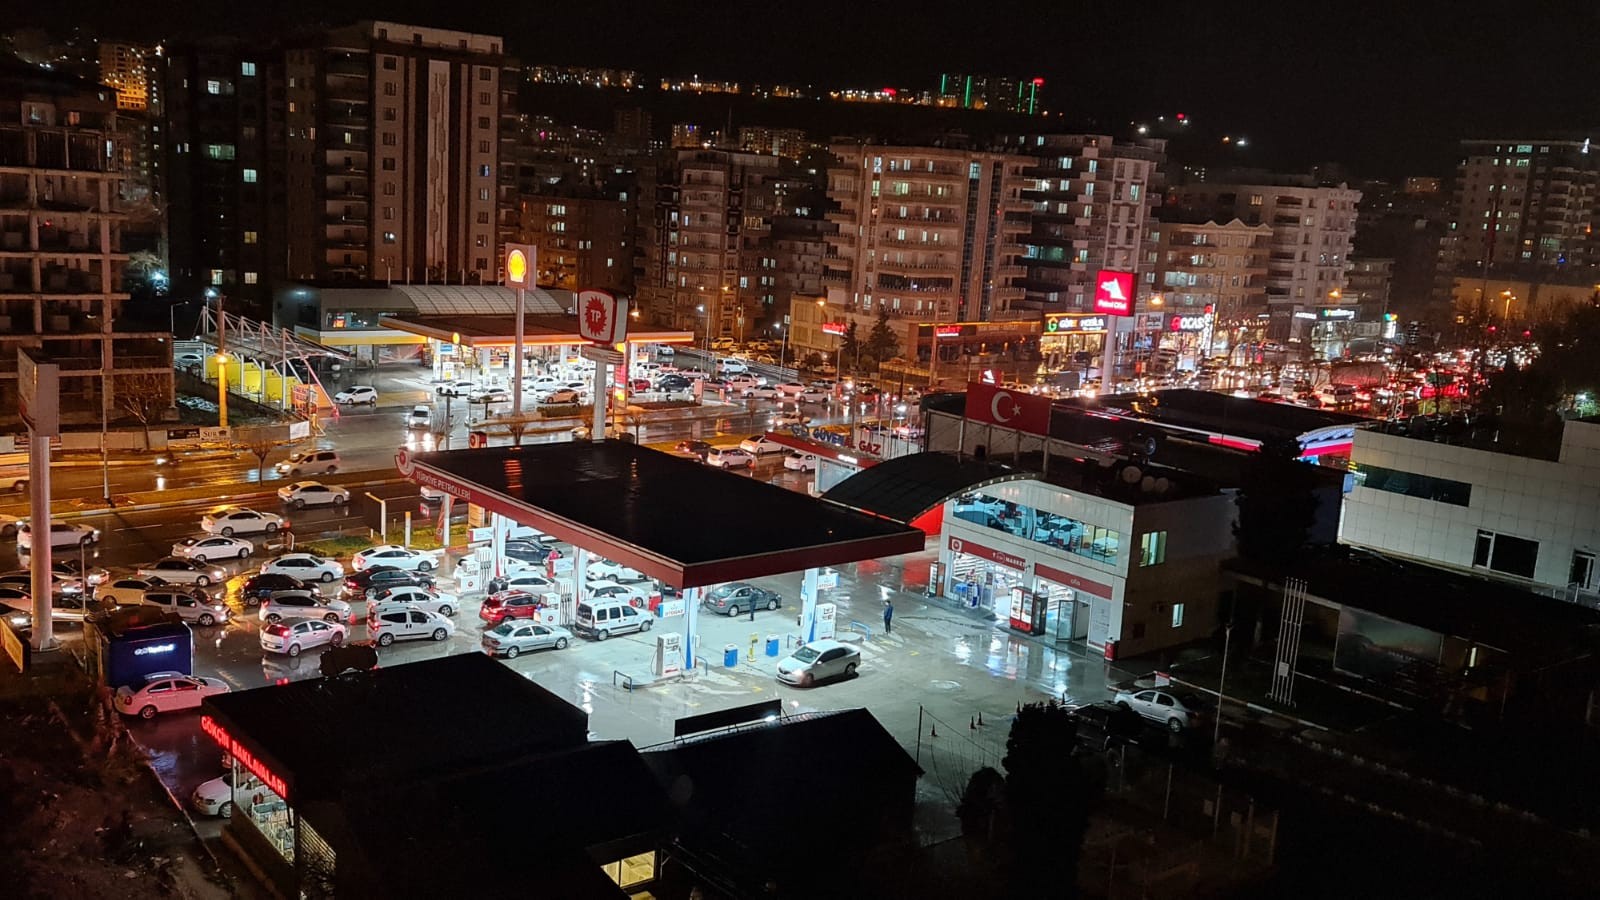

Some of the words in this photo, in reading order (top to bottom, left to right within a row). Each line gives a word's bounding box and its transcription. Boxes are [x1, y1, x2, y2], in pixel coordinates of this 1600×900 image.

[590, 309, 602, 323] TP
[858, 440, 881, 456] GAZ
[232, 740, 287, 799] BAKLAVALARI
